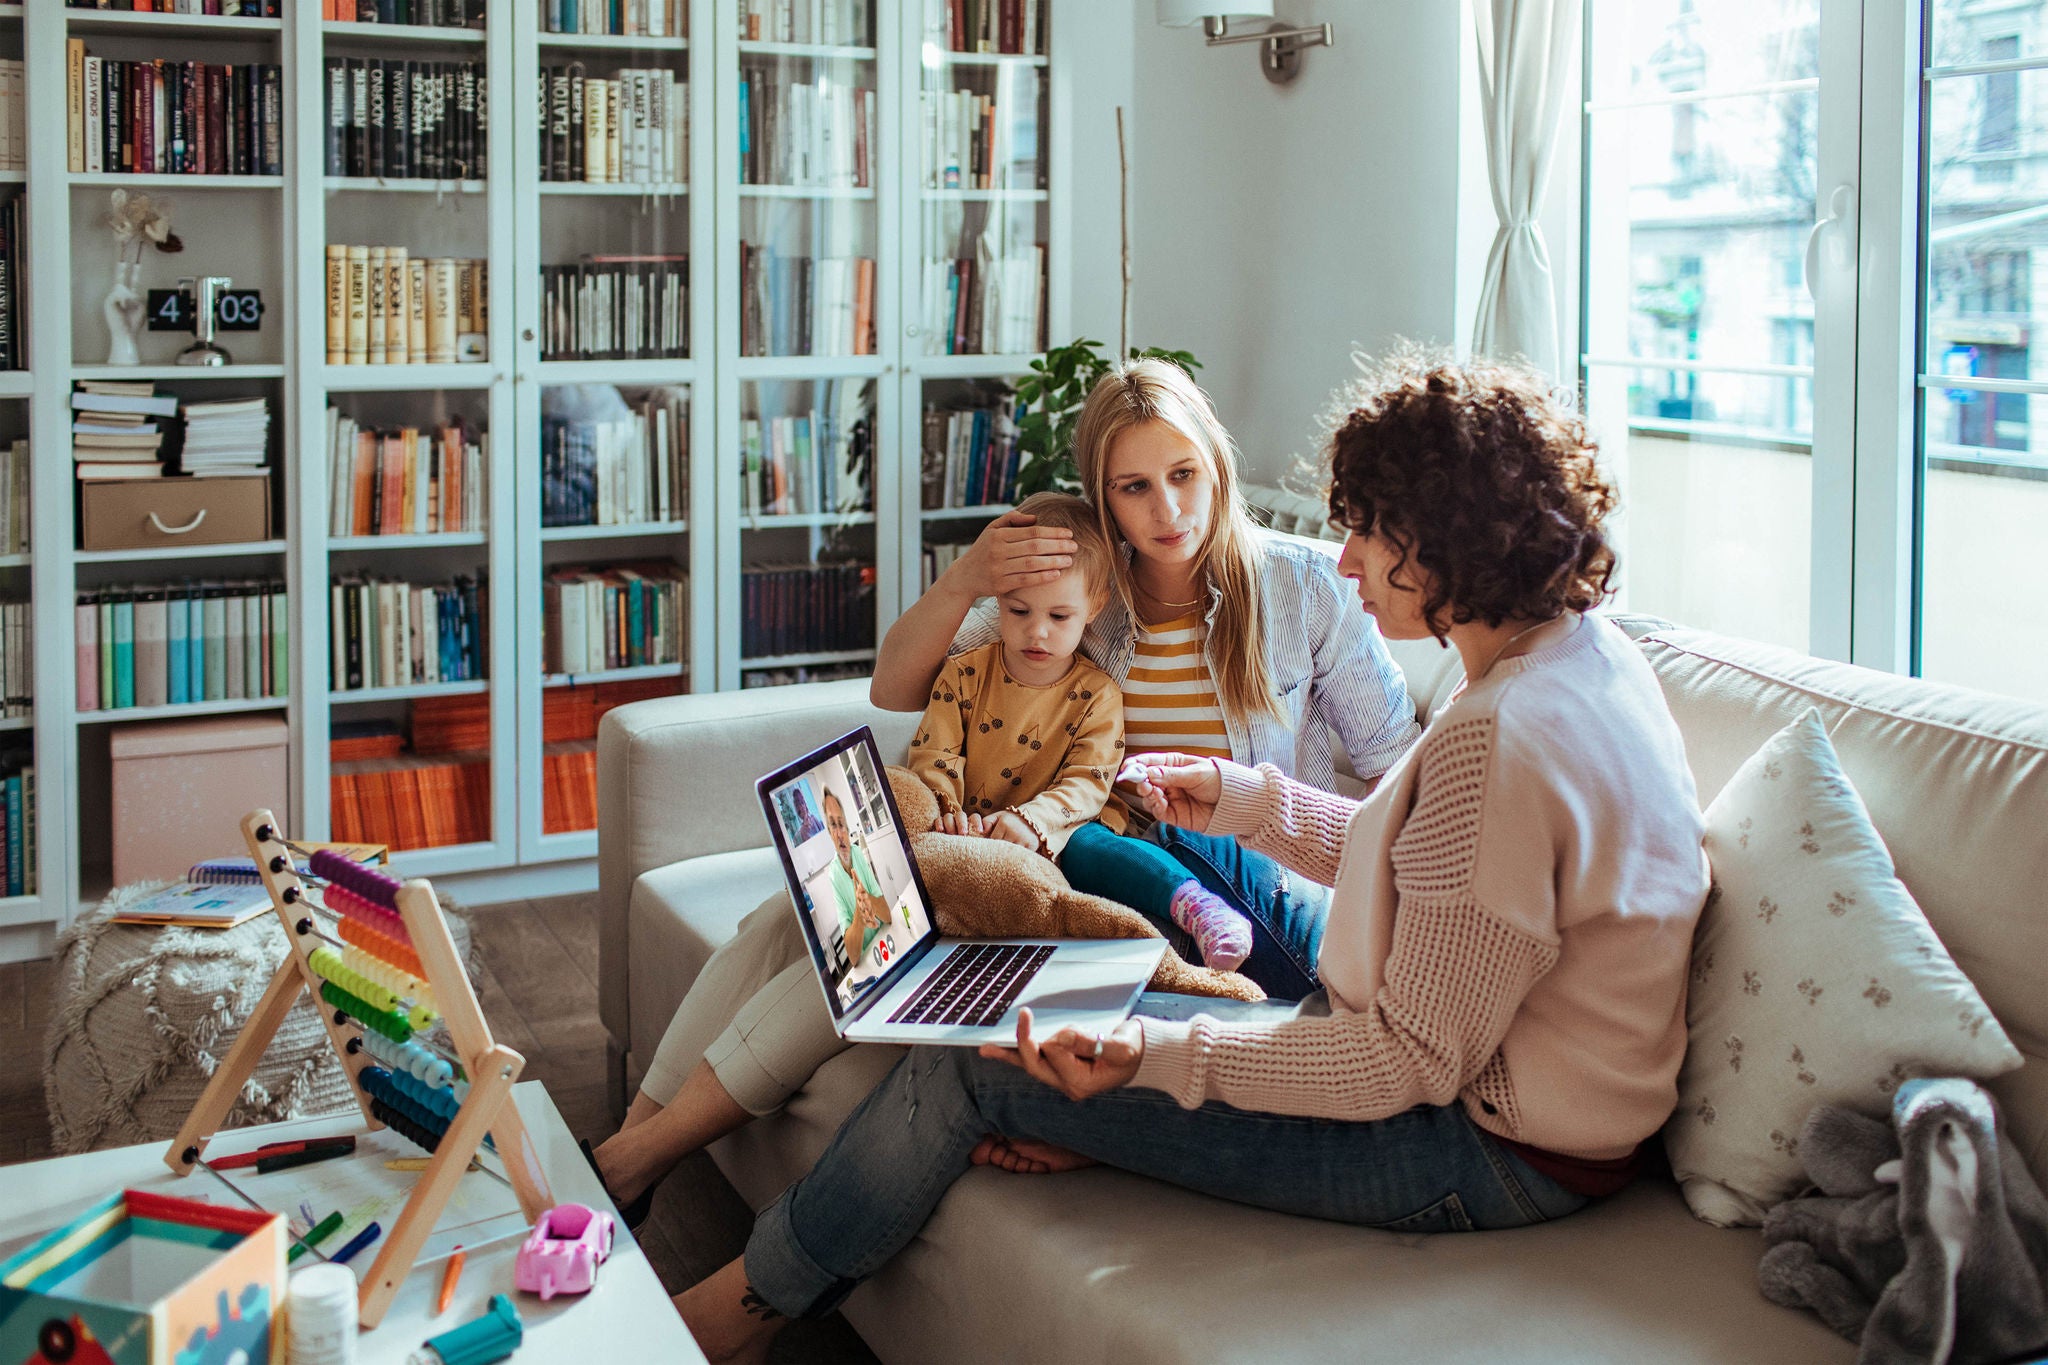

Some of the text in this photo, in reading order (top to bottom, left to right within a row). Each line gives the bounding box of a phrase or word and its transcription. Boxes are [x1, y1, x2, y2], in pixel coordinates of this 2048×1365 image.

[371, 69, 385, 127] ADORNO
[392, 71, 405, 131] HARTMAN
[553, 76, 568, 136] PLATON
[159, 295, 260, 323] 4 03
